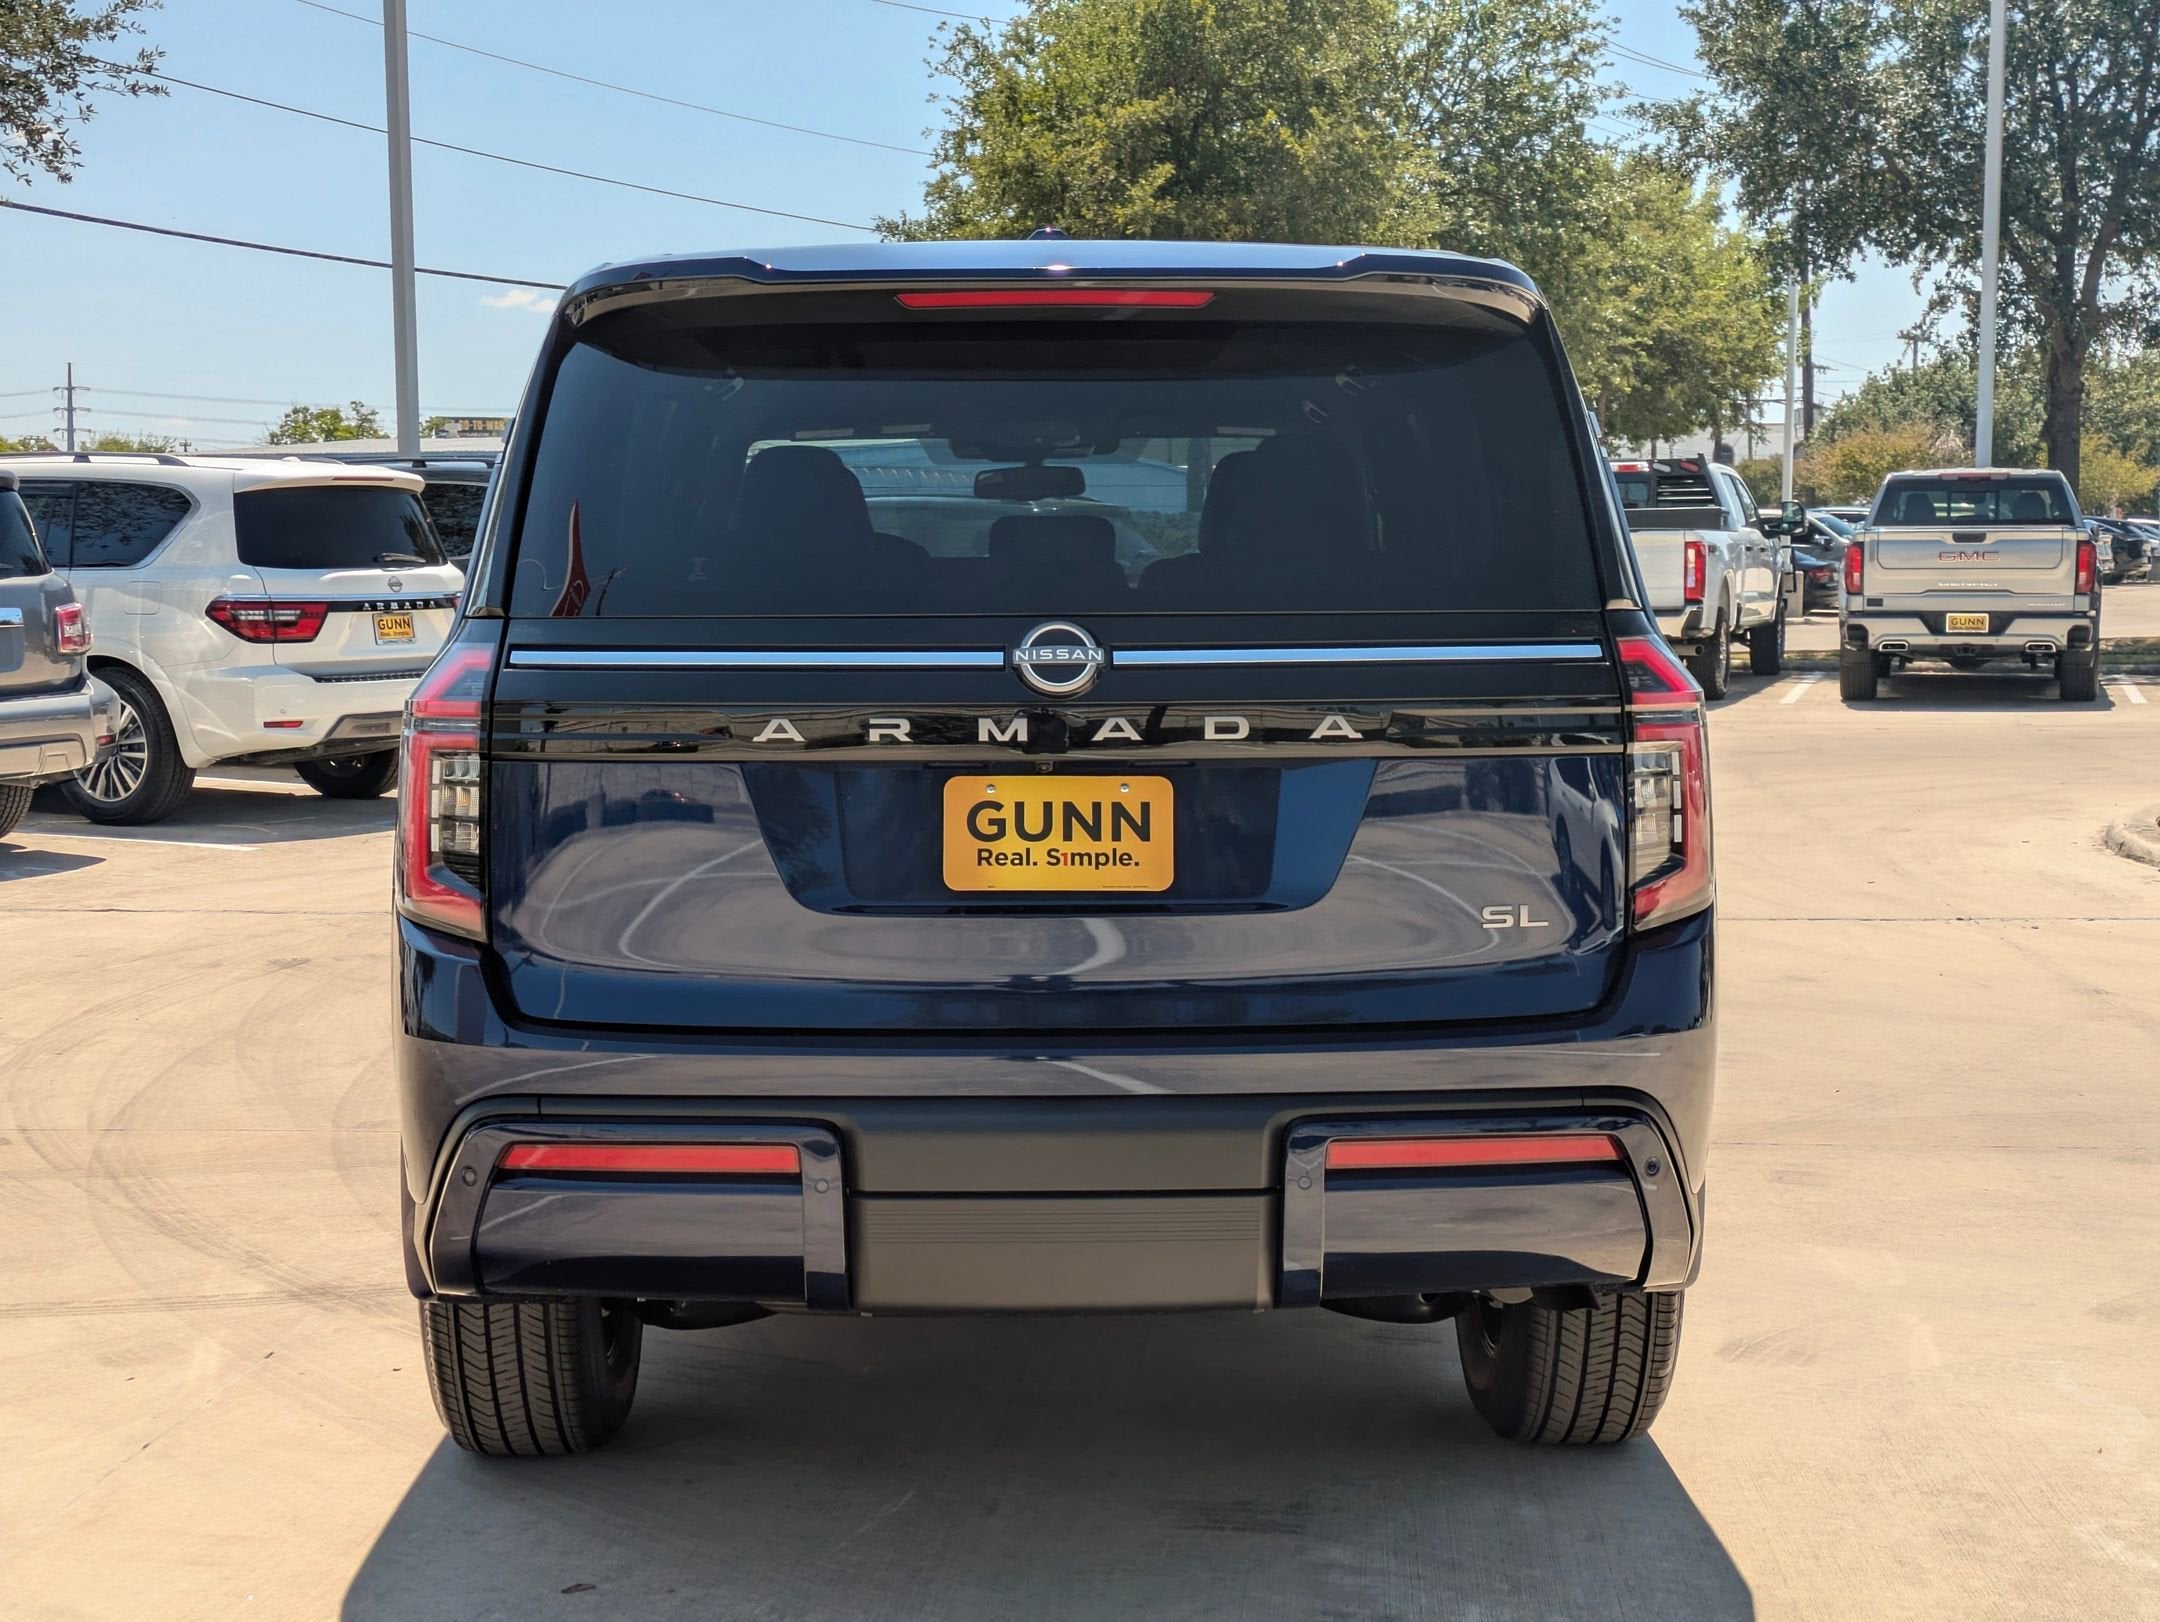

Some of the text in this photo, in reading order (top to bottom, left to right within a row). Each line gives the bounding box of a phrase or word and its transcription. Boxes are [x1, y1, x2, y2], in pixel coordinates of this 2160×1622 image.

[1938, 551, 2000, 562] GMC
[362, 600, 436, 611] ARMADA
[377, 617, 411, 630] GUNN
[1951, 617, 1985, 626] GUNN
[1015, 649, 1102, 661] NISSAN
[752, 716, 1364, 743] ARMADA
[966, 800, 1151, 843] GUNN
[976, 847, 1038, 867] Real.
[1481, 904, 1549, 929] SL
